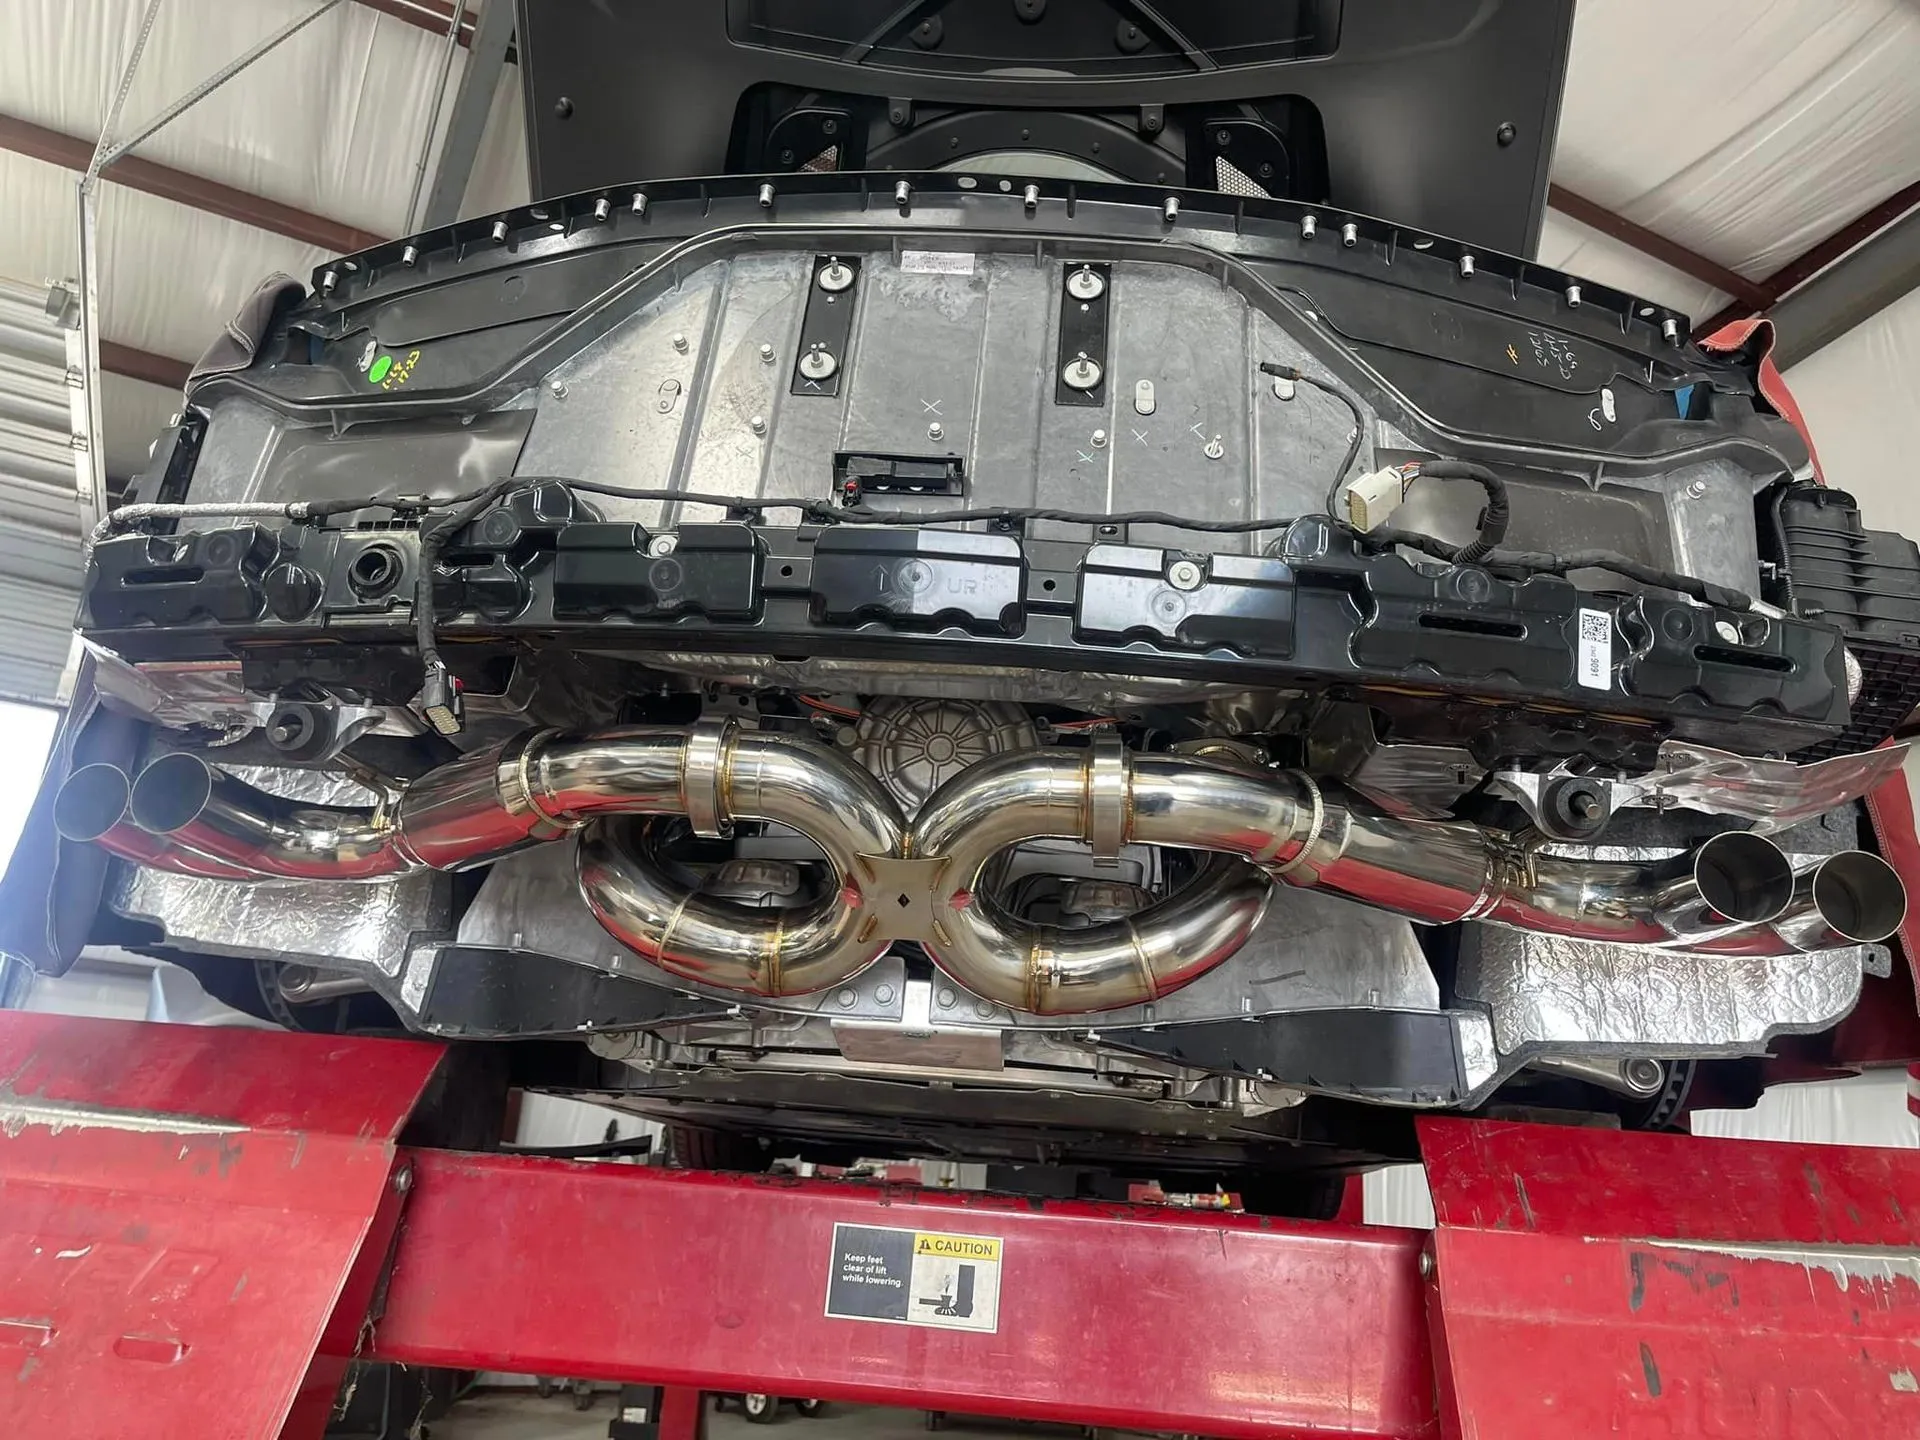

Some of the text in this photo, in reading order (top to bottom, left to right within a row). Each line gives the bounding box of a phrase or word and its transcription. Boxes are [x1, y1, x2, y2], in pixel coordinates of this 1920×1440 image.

[935, 1240, 993, 1256] CAUTION
[844, 1252, 884, 1265] Keep feet
[843, 1263, 887, 1275] clear of lift
[842, 1274, 864, 1283] while
